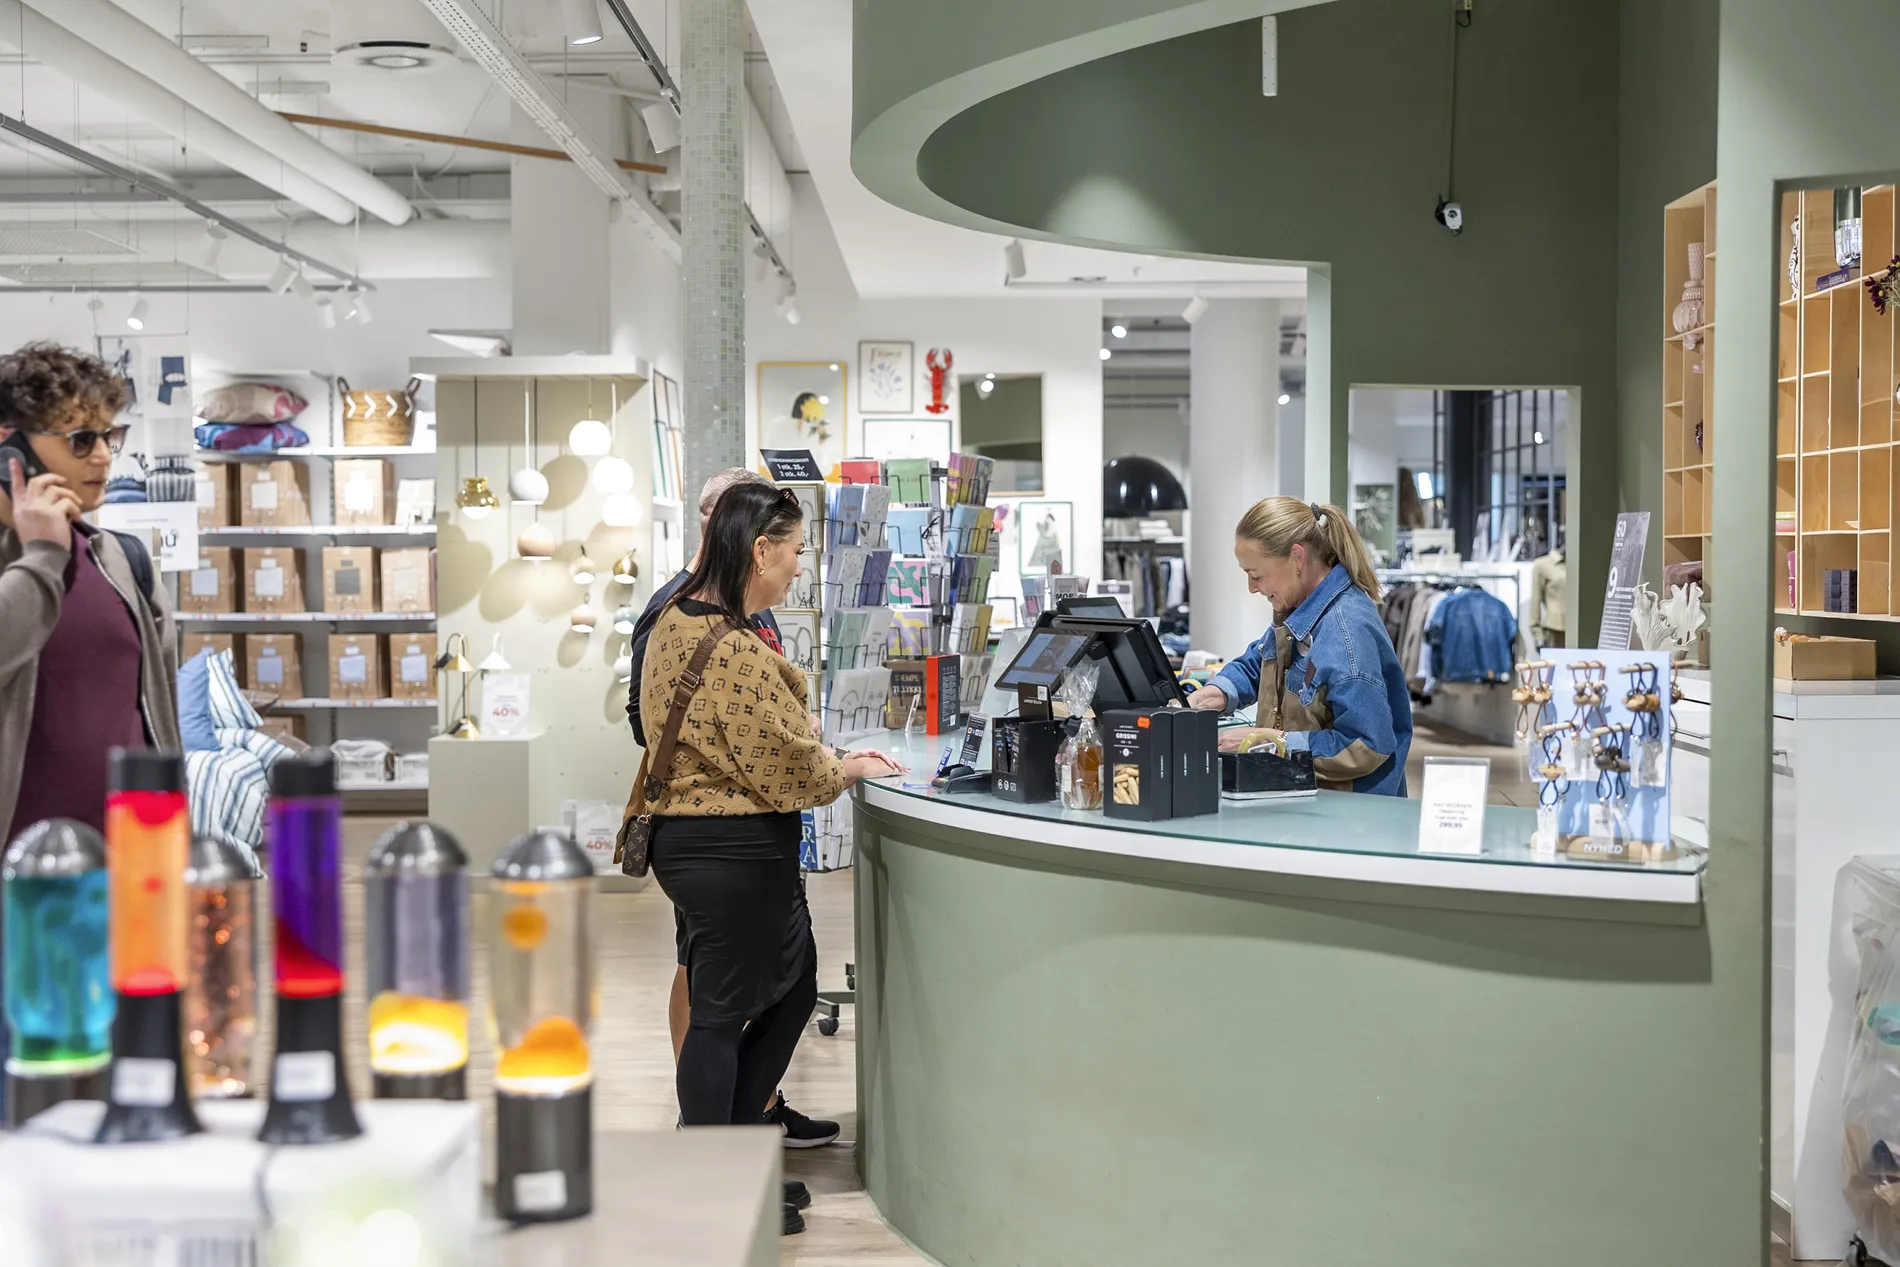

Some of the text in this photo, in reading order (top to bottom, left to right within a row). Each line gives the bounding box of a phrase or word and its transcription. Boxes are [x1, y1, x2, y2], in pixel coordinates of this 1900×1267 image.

[798, 653, 815, 672] ÅR
[492, 706, 520, 717] 40%
[1115, 732, 1137, 740] GRISSINI
[586, 840, 615, 852] 40%
[1583, 843, 1623, 854] NYHED
